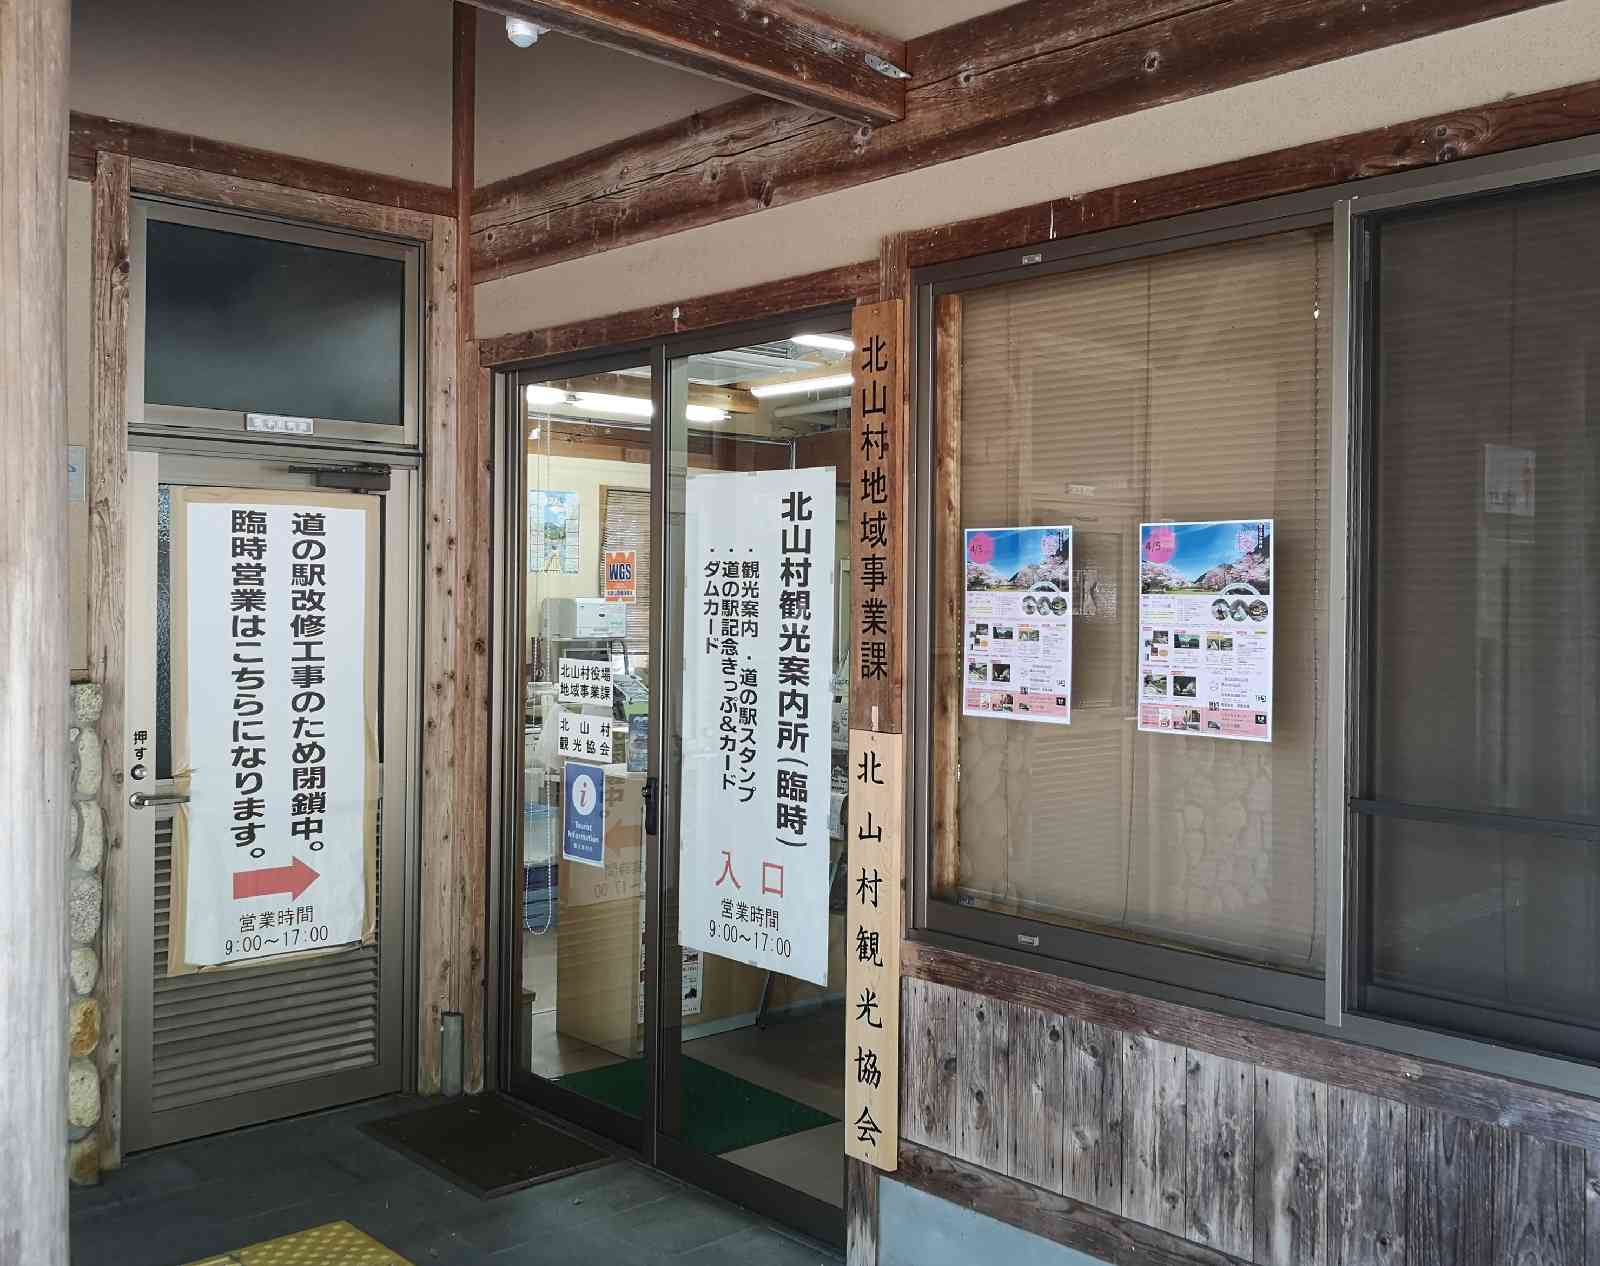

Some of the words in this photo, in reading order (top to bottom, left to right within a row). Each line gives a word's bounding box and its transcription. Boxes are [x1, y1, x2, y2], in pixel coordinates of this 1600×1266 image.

[860, 337, 888, 685] 北山村地域事業課
[608, 562, 632, 581] WGS
[230, 509, 267, 860] 臨時営業はこちらになります。
[290, 511, 327, 852] 道の駅改修工事のため閉鎖中。
[560, 664, 611, 682] 北山村役場
[560, 681, 611, 700] 地域事業課
[133, 730, 148, 766] 押す
[559, 736, 610, 756] 観光協会
[714, 851, 784, 898] 入口
[239, 908, 315, 933] 営業時間
[720, 898, 780, 931] 営業時間
[855, 752, 883, 1147] 北山村観光協会
